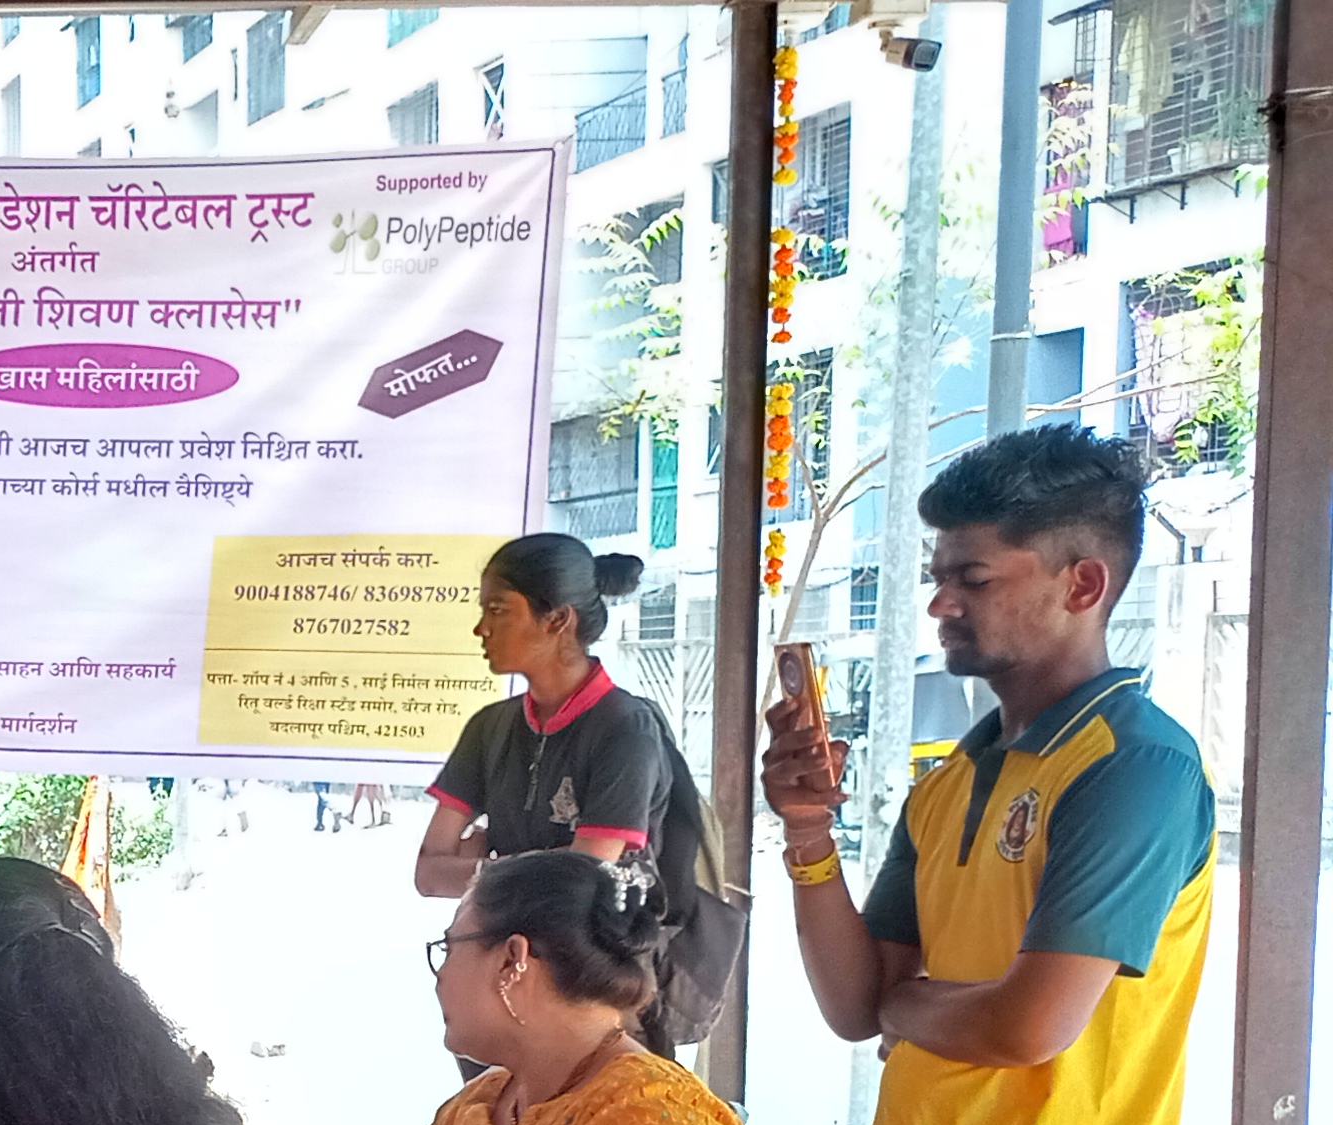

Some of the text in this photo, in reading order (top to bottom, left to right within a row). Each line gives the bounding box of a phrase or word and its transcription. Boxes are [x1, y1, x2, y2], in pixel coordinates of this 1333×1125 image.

[376, 171, 488, 195] Supported by
[245, 192, 315, 243] ट्रस्ट
[386, 215, 531, 251] PolyPeptide
[11, 242, 100, 273] अंतर्गत
[382, 258, 439, 275] GROUP
[33, 286, 139, 330] शिवण
[56, 358, 200, 394] महिलांसाठी
[19, 438, 90, 457] आजच
[96, 439, 174, 459] आपला
[179, 431, 235, 460] प्रवेश
[241, 431, 311, 462] निश्चित
[317, 440, 364, 460] करा.
[51, 471, 101, 497] कोर्स
[106, 473, 171, 498] मधील
[175, 473, 253, 507] वैशिष्ट्ये
[276, 547, 440, 569] आजच संपर्क करा-
[234, 585, 358, 602] 9004188746/
[292, 618, 411, 636] 8767027582
[49, 656, 102, 678] आणि
[105, 658, 177, 681] सहकार्य
[242, 671, 271, 686] शॉप
[300, 671, 338, 687] आणि
[340, 676, 350, 688] 5
[361, 673, 388, 690] साई
[391, 673, 430, 690] निर्मल
[0, 712, 78, 735] मार्गदर्शन
[269, 721, 324, 739] बदलापूर
[373, 725, 425, 738] 421503
